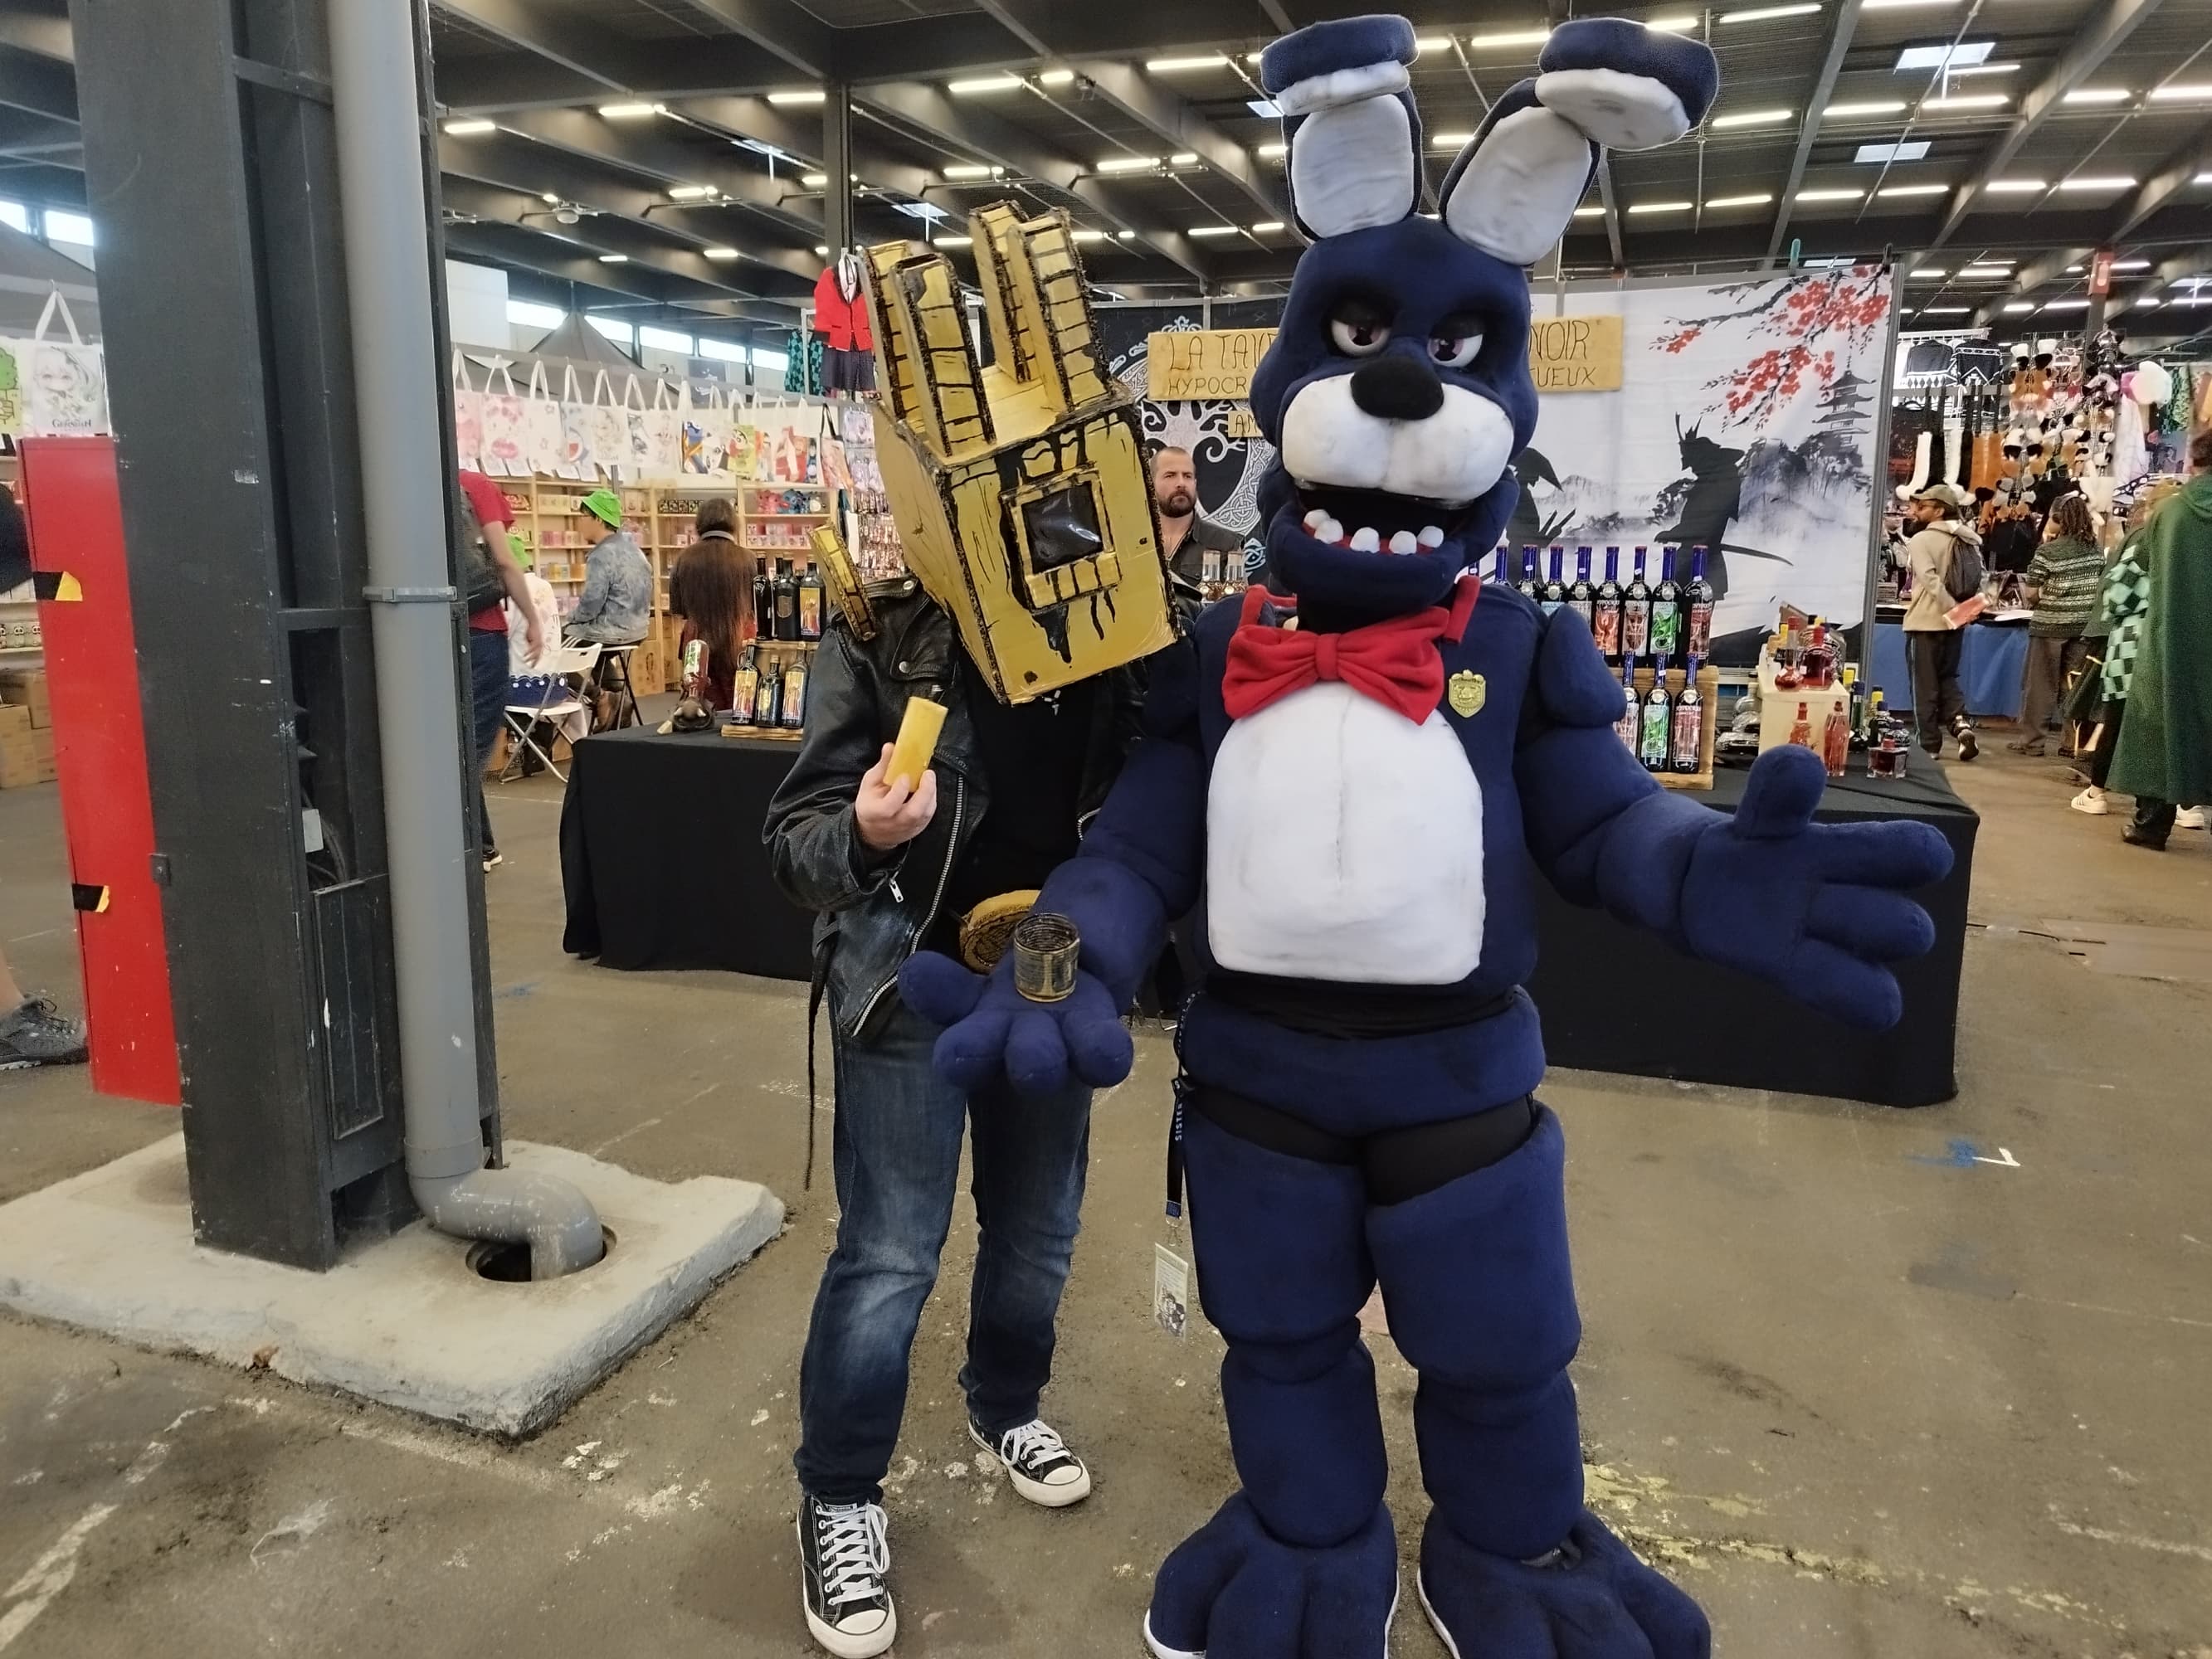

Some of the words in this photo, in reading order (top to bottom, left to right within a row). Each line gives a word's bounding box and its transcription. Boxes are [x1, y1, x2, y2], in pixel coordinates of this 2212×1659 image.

[1170, 335, 1203, 371] LA
[1529, 320, 1590, 361] NOIR
[1168, 377, 1248, 395] HYPOCR
